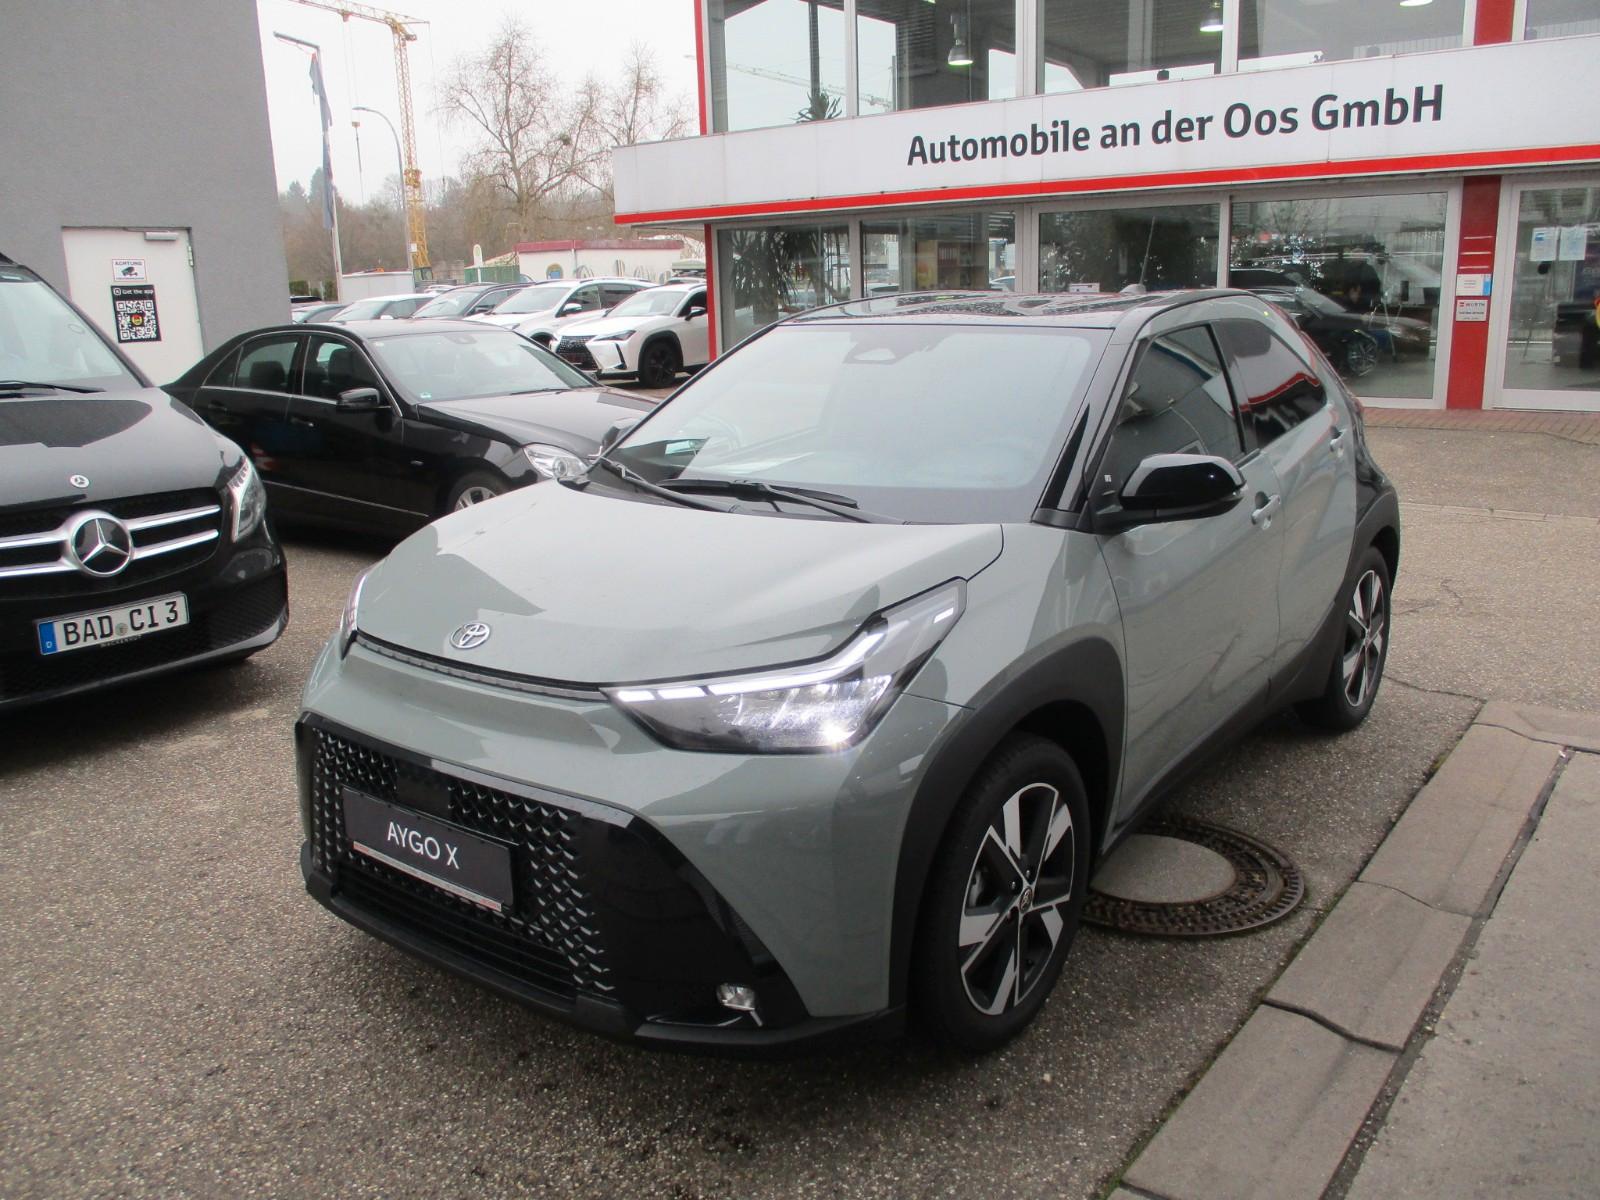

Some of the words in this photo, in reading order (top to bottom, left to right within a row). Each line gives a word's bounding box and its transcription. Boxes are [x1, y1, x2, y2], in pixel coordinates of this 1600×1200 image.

[907, 120, 1091, 166] Automobile
[1100, 121, 1140, 149] an
[1151, 109, 1213, 144] der
[1223, 103, 1299, 138] Oos
[1311, 84, 1443, 131] GmbH
[63, 615, 114, 646] BAD
[129, 605, 159, 631] CI
[165, 601, 178, 624] 3
[387, 821, 441, 860] AYGO
[445, 843, 460, 870] X
